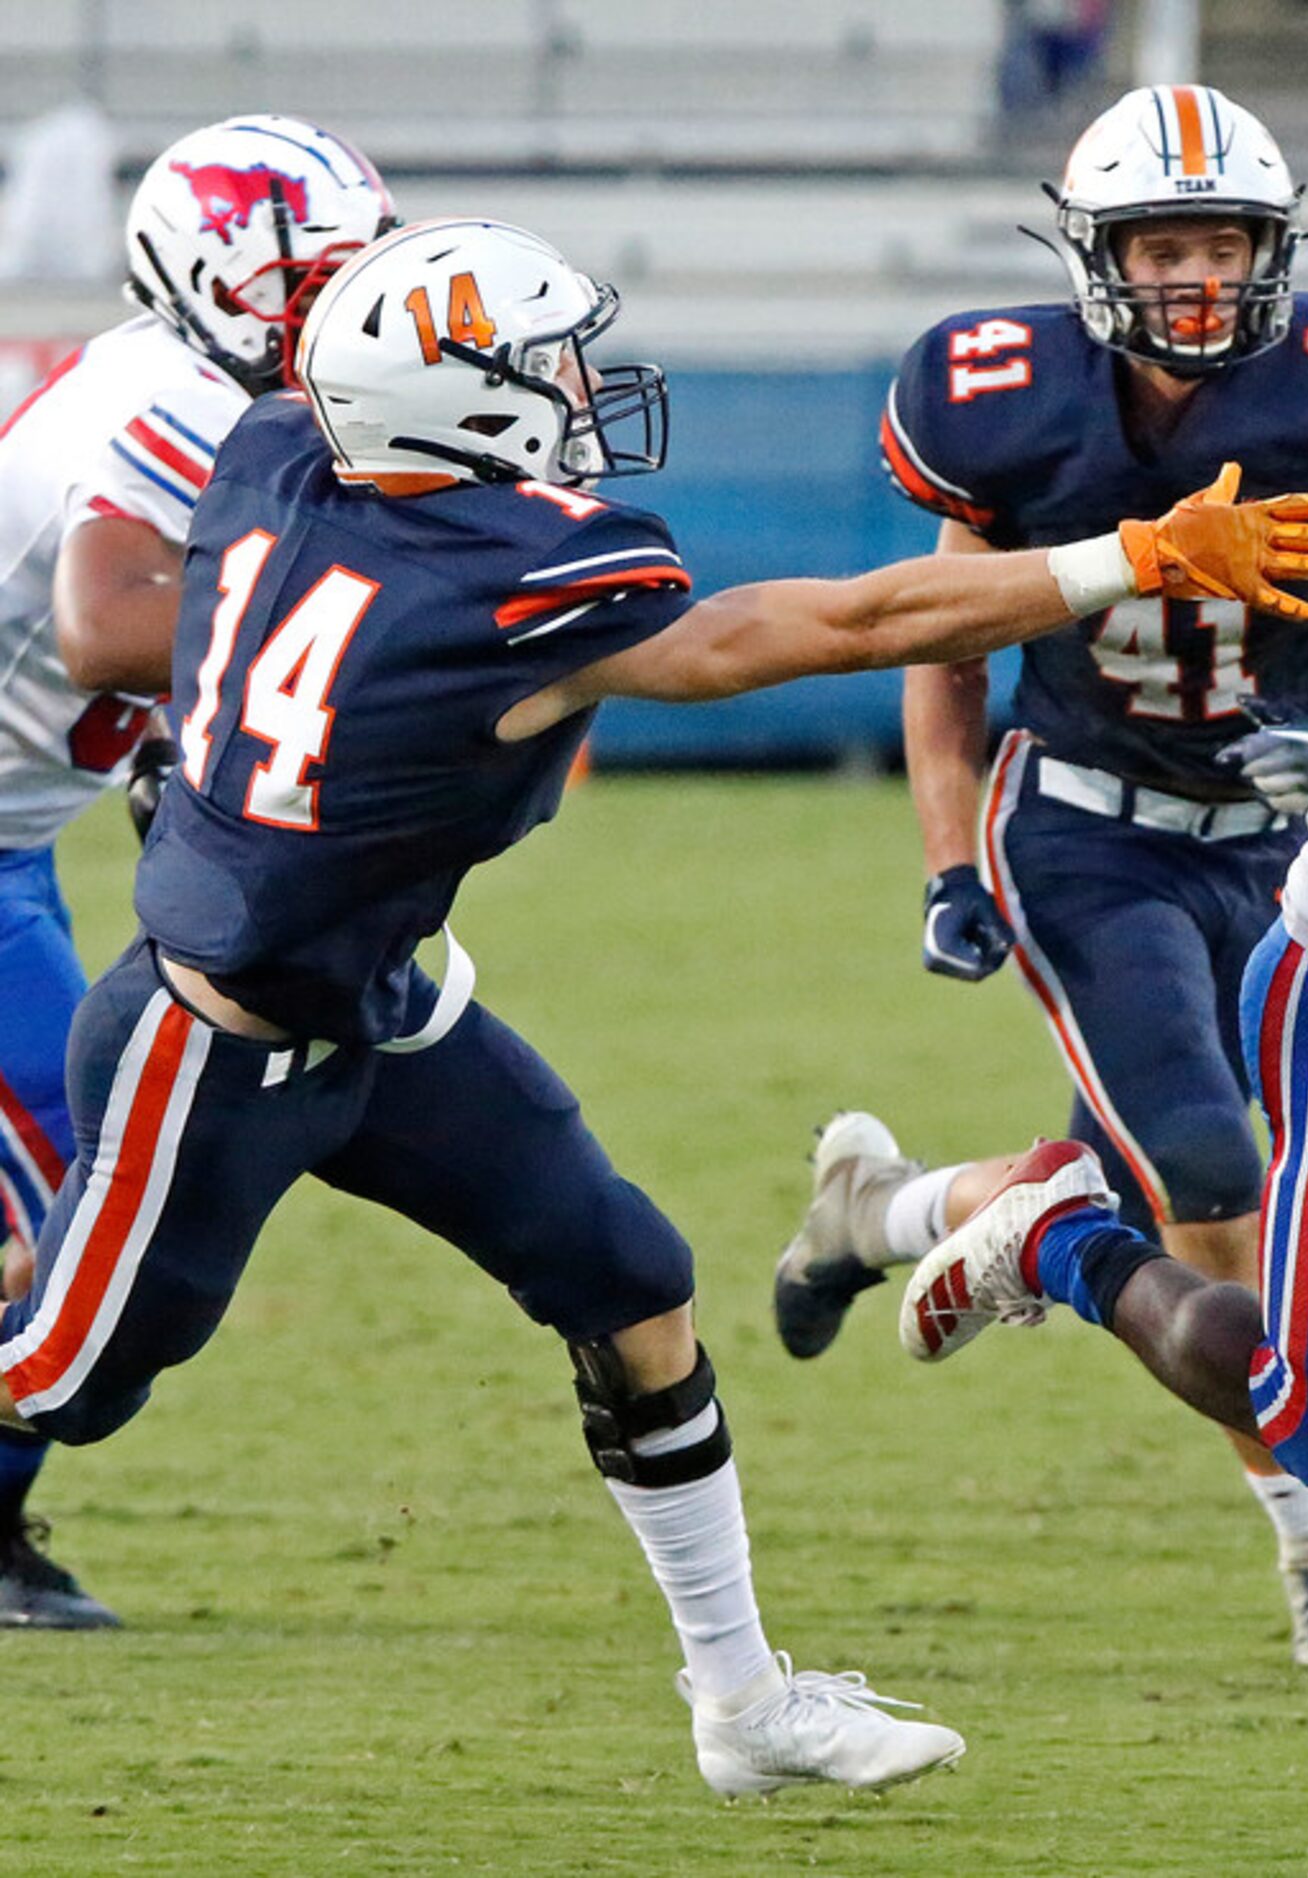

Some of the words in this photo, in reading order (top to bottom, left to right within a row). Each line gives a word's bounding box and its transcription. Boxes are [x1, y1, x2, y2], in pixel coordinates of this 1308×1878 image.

[1174, 178, 1217, 194] TEAM
[403, 271, 498, 366] 14
[949, 318, 1033, 404] 41
[180, 527, 383, 832] 14
[1088, 596, 1259, 722] 41
